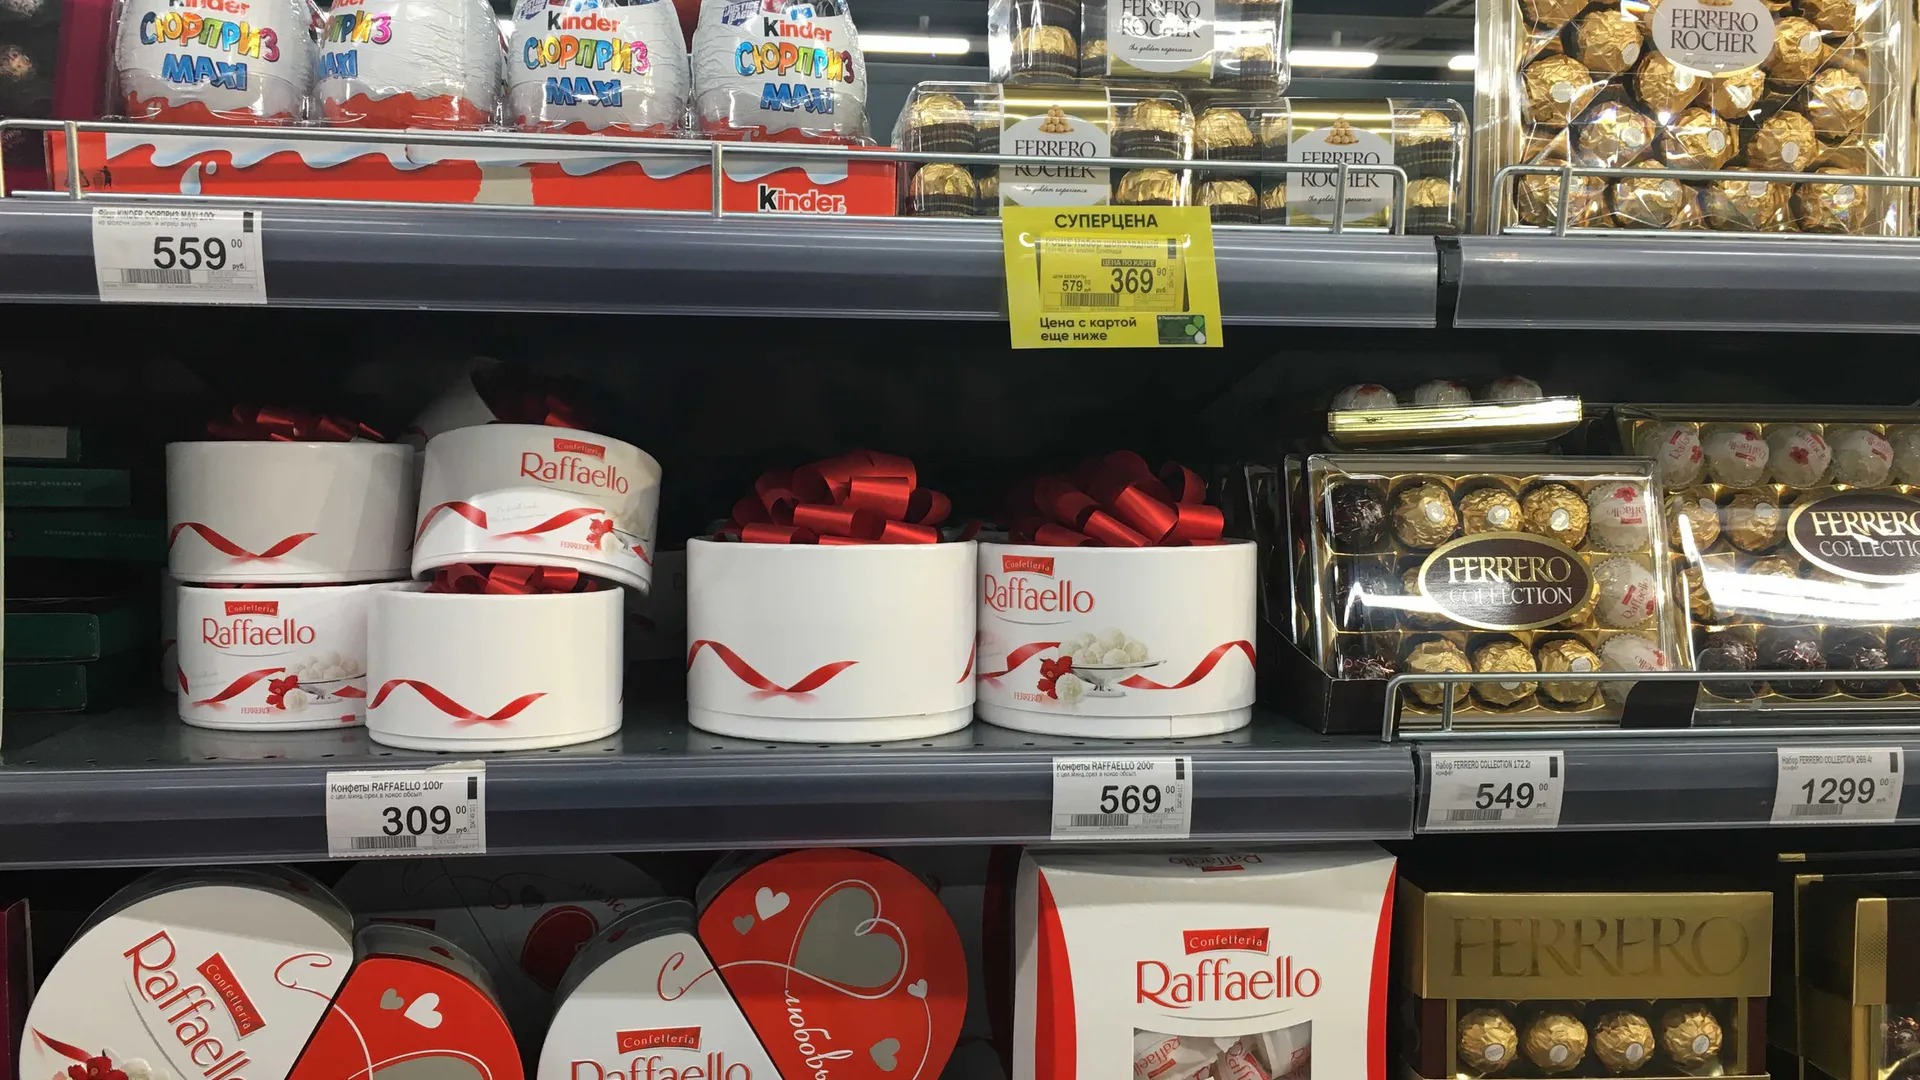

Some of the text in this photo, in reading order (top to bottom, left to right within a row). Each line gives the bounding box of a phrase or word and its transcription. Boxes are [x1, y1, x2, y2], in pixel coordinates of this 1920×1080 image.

[322, 10, 392, 45] ПРИЗ
[547, 11, 620, 33] Kinder
[763, 17, 832, 42] Kinder
[1121, 18, 1201, 38] ROCR
[1671, 8, 1758, 32] FERRERO
[140, 11, 280, 62] СЮРПРИЗ
[1670, 29, 1757, 54] ROCHER
[523, 35, 651, 76] СЮРПРИЗ
[1140, 44, 1160, 54] golden
[1161, 46, 1193, 55] experience
[162, 53, 248, 91] MAXI
[735, 41, 855, 84] СЮРПРИЗ
[546, 77, 623, 108] MAXI
[761, 83, 834, 115] MAXI
[1015, 140, 1097, 157] FERRERO
[759, 184, 844, 214] Kinder
[1055, 186, 1088, 196] experience
[1317, 194, 1335, 204] golde
[1345, 196, 1372, 205] perience
[1055, 214, 1159, 230] СУПЕРЦЕНА
[154, 237, 243, 270] 559 00
[1062, 280, 1082, 291] 579
[1110, 268, 1153, 293] 369
[1157, 268, 1167, 276] 90
[1040, 317, 1137, 329] Цена с картой
[1041, 332, 1108, 342] еще ниже
[520, 452, 629, 494] Raffaello
[1606, 507, 1647, 518] affaello
[1446, 556, 1572, 583] FERRERO
[984, 574, 1094, 613] Raffaello
[203, 618, 316, 648] Raffaello
[1056, 761, 1155, 772] Конфеты RAFFAELLO 200г
[1436, 761, 1453, 769] Набор
[1454, 760, 1479, 769] FERRERO
[1480, 760, 1513, 769] COLLECTION
[1782, 757, 1798, 765] Набор
[1799, 756, 1823, 764] FERRERO
[1825, 755, 1855, 763] COLLECTION
[331, 780, 444, 793] Конфеты RAFFAELLO 100г
[1475, 783, 1548, 809] 549 00
[1802, 778, 1875, 804] 1299
[1880, 778, 1889, 786] 00
[1100, 785, 1161, 814] 569
[382, 805, 451, 836] 309
[456, 806, 467, 814] 00
[1189, 935, 1263, 949] Confetteria
[1450, 916, 1749, 978] FERRERO
[1136, 955, 1321, 1009] Raffaello
[123, 930, 252, 1080] Raffaell
[206, 963, 251, 1030] Confetteria
[623, 1034, 695, 1048] Confetteria
